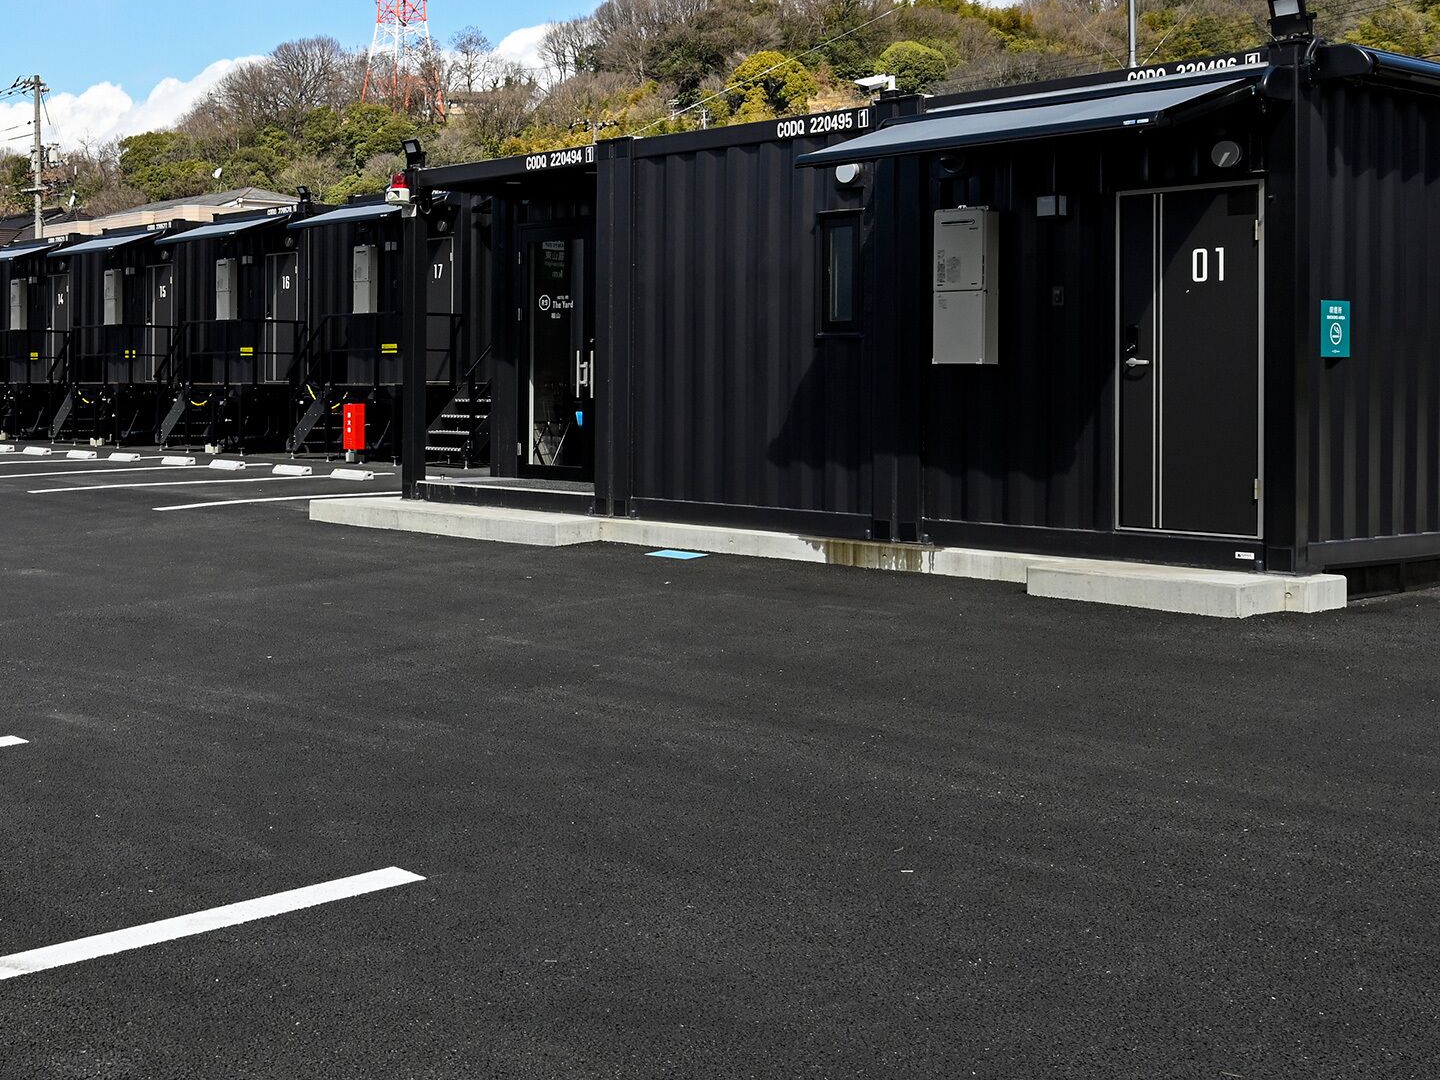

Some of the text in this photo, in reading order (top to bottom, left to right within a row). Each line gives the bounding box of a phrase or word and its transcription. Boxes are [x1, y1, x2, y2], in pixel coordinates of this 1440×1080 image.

[777, 119, 805, 138] CODQ
[809, 112, 853, 134] 220495
[526, 154, 547, 170] CODQ
[550, 149, 582, 167] 220494
[433, 263, 443, 279] 17
[1192, 247, 1225, 282] 01
[282, 275, 290, 289] 16
